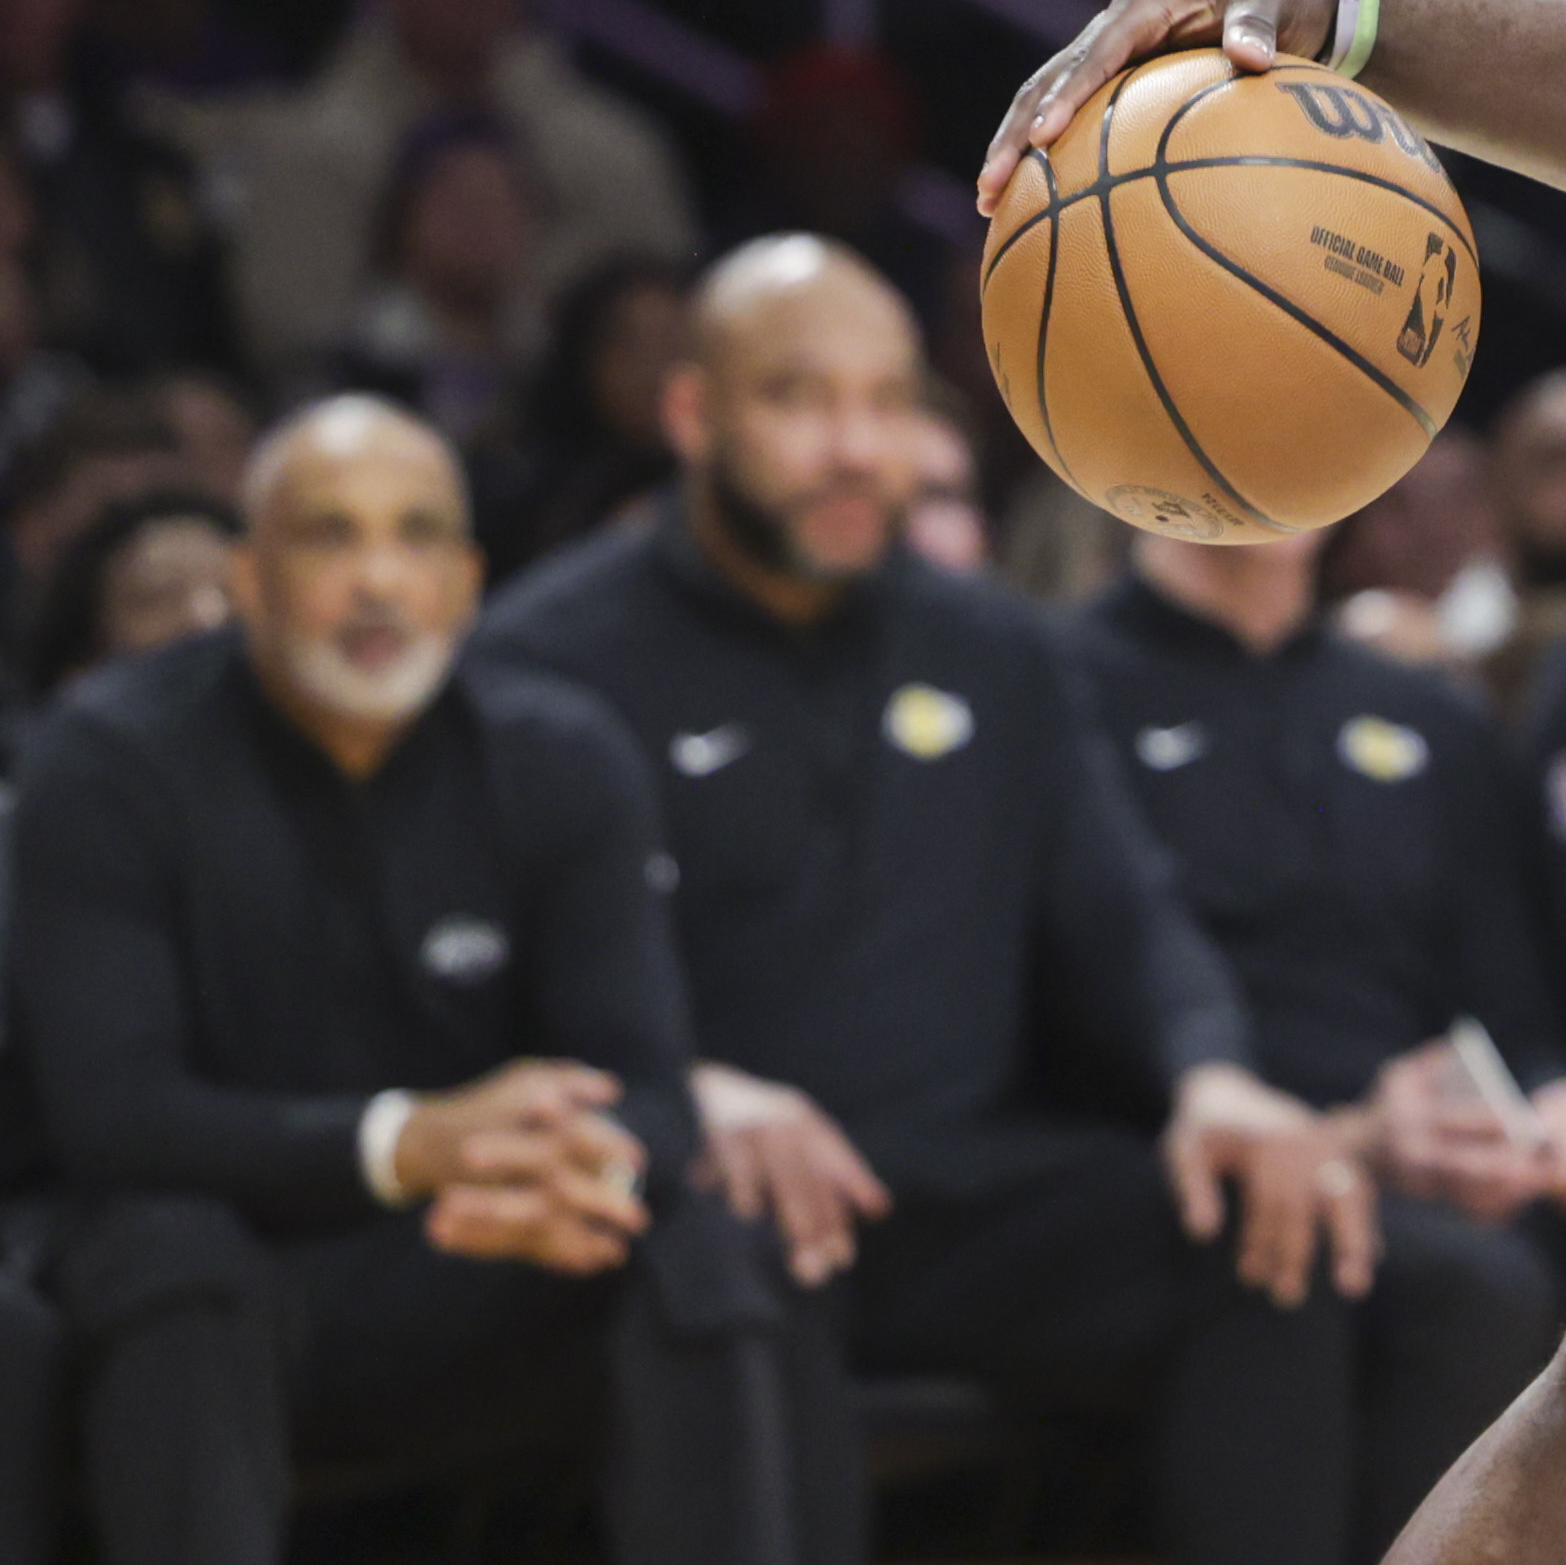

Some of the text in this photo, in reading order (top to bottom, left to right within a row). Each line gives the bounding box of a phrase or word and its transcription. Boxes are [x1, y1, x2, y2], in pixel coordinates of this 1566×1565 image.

[1309, 225, 1356, 261] OFFICIAL
[1356, 246, 1384, 276] GAME
[1384, 261, 1405, 289] BALL
